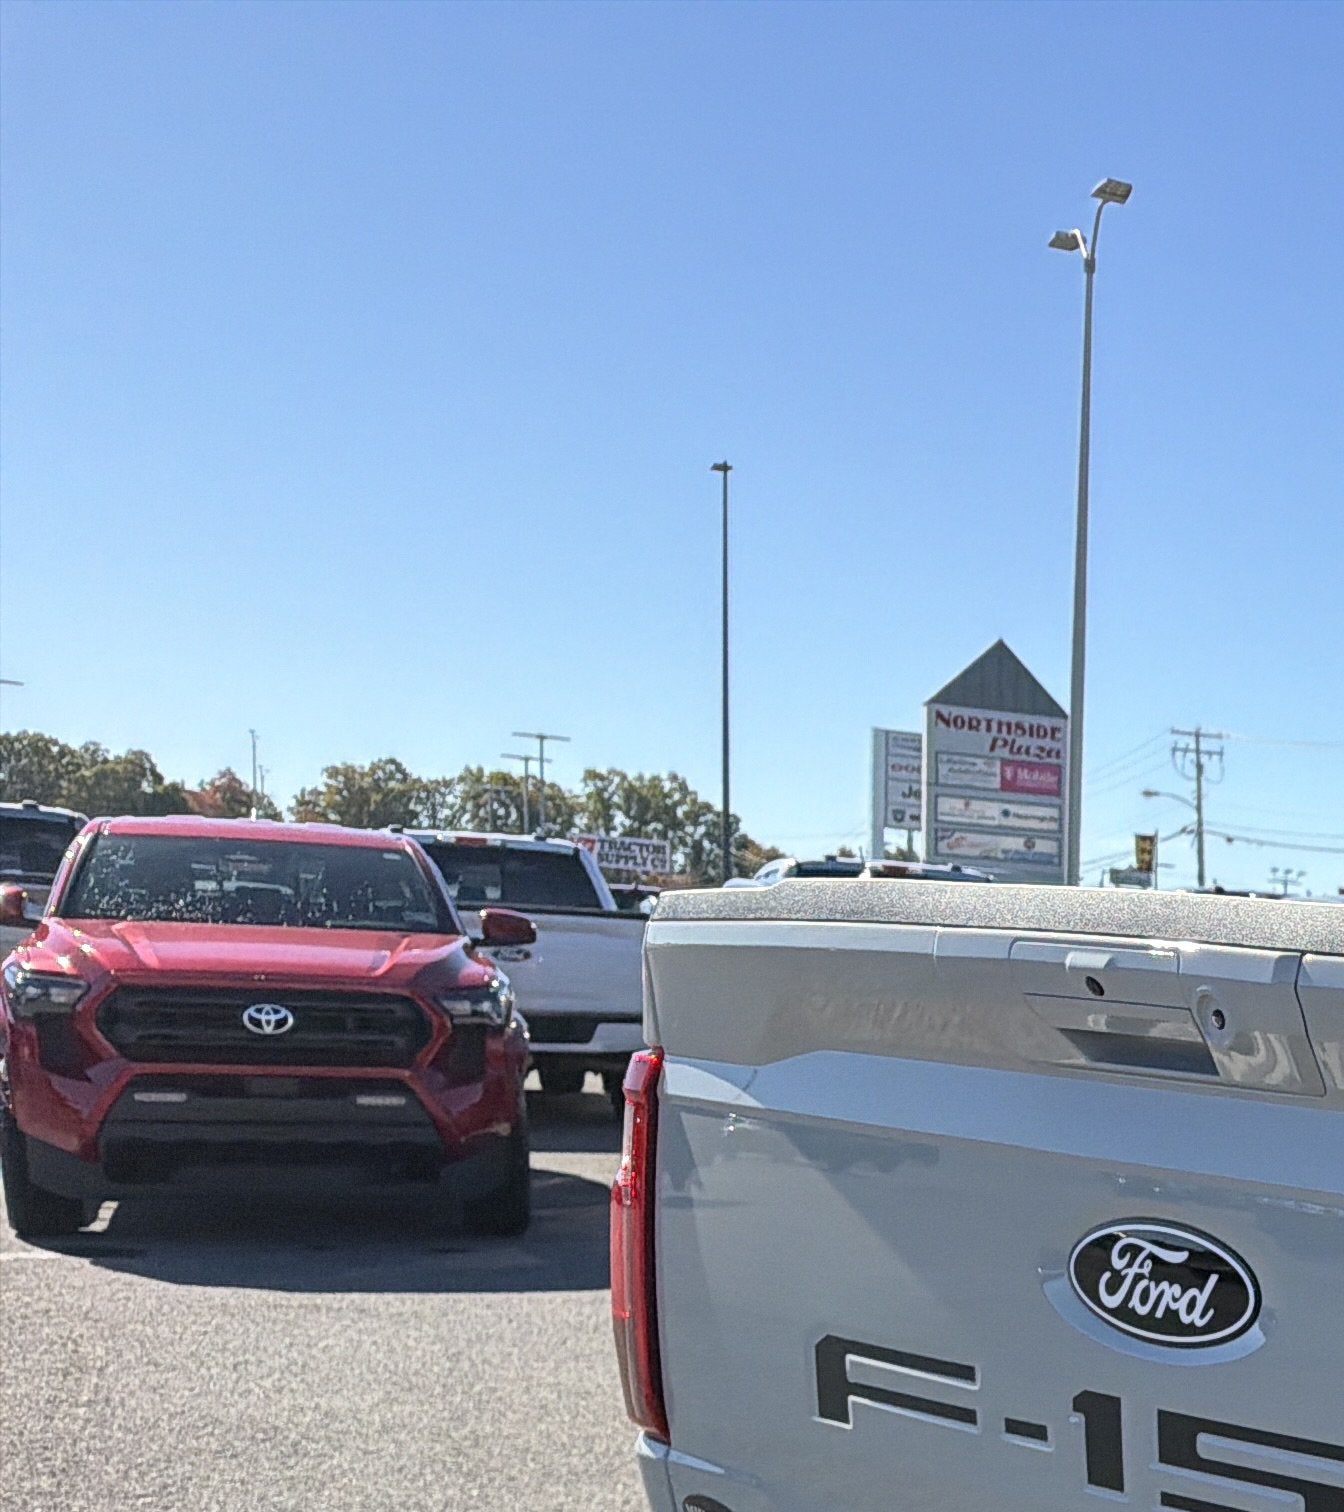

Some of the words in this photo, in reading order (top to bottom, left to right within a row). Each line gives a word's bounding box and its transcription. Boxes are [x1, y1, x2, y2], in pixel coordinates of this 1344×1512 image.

[935, 709, 1062, 742] NORTHSIDE
[989, 736, 1062, 760] Plaza
[1099, 1237, 1219, 1328] Ford
